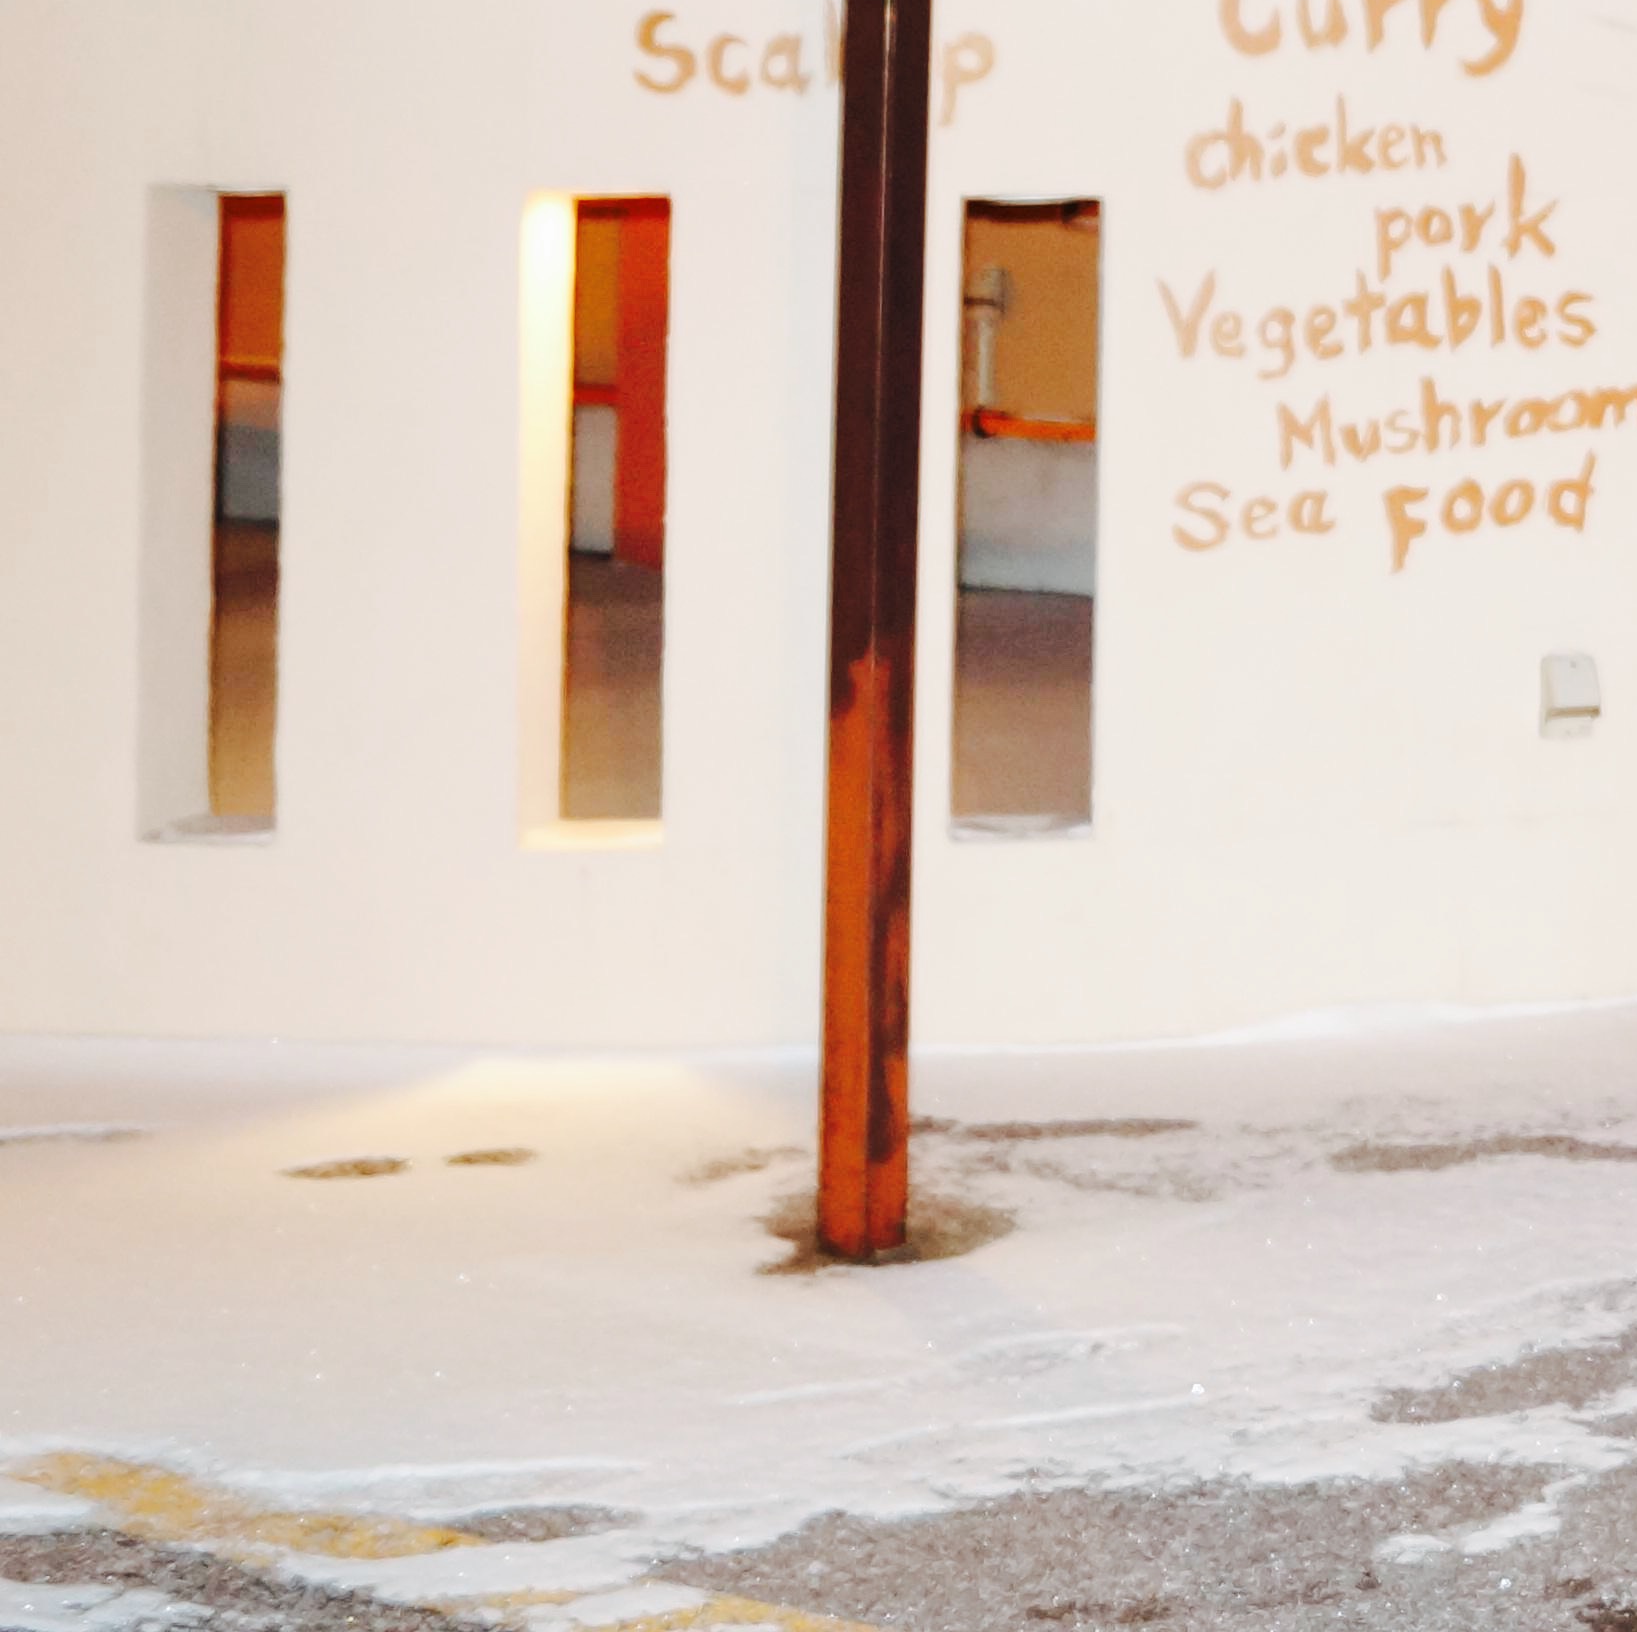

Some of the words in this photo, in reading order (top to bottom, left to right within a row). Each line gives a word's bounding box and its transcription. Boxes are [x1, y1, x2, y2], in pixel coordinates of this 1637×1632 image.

[1373, 152, 1562, 279] pork
[1158, 264, 1600, 379] Vegetables
[1172, 479, 1338, 555] Sea
